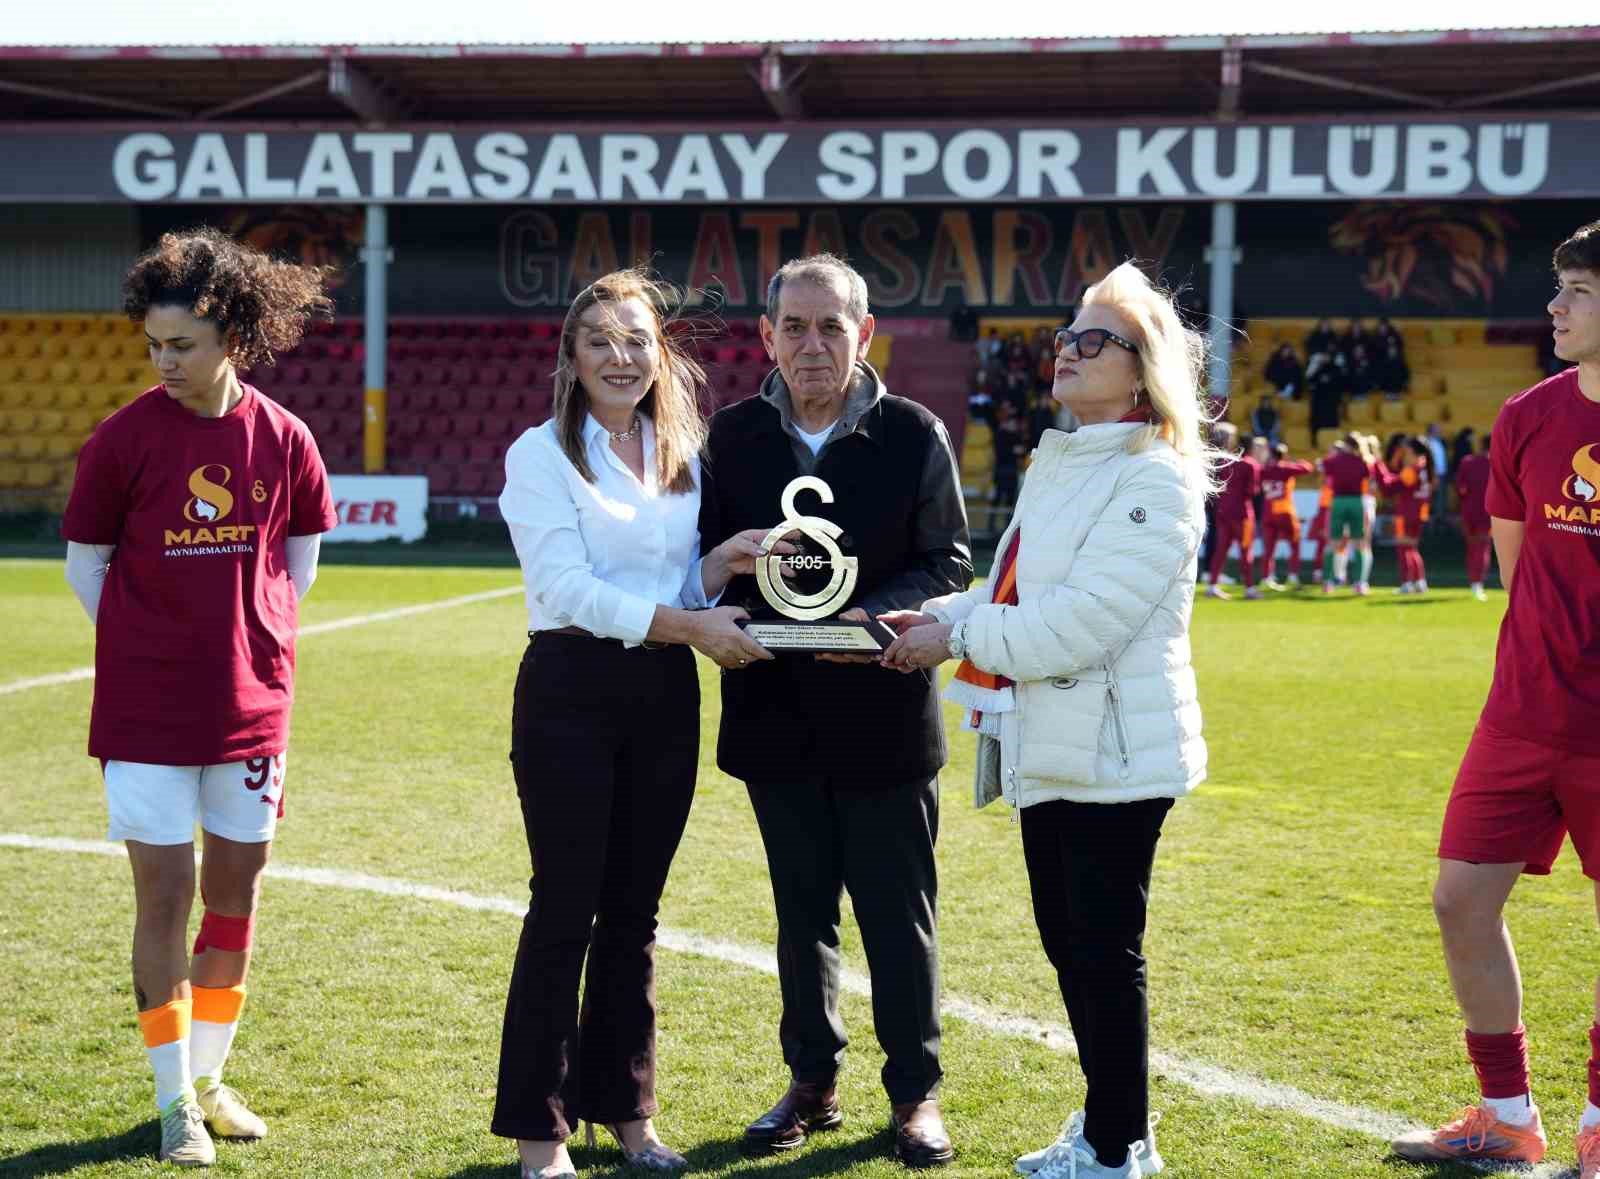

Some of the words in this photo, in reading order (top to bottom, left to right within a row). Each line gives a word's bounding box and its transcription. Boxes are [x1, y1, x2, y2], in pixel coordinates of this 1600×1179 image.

[112, 131, 789, 200] GALATASARAY
[816, 129, 1084, 200] SPOR
[1116, 123, 1549, 197] KULÜBÜ
[164, 525, 256, 546] MART
[788, 555, 823, 570] 1905
